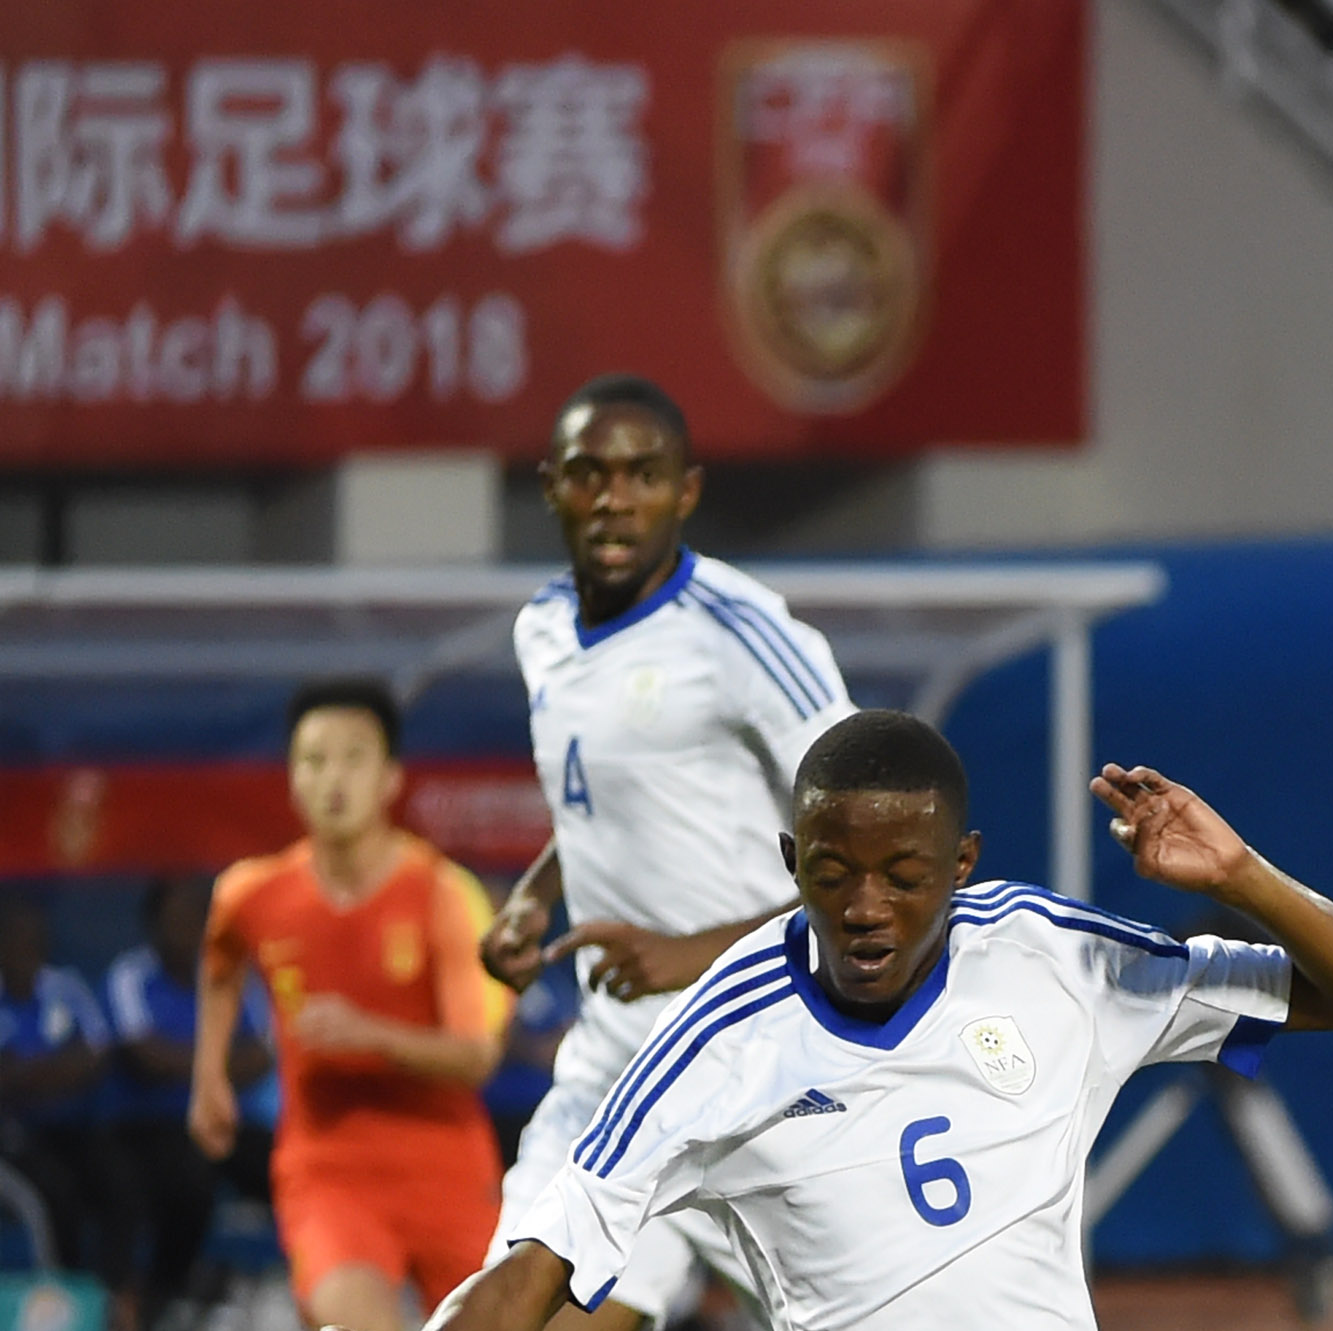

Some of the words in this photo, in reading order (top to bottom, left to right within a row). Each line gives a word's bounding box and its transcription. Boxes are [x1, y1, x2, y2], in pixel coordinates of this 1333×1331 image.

[0, 58, 648, 252] 际足球赛
[302, 294, 524, 400] 2018
[564, 736, 594, 817] 4
[783, 1102, 847, 1118] adidas
[984, 1054, 1026, 1075] NFA
[900, 1115, 971, 1227] 6
